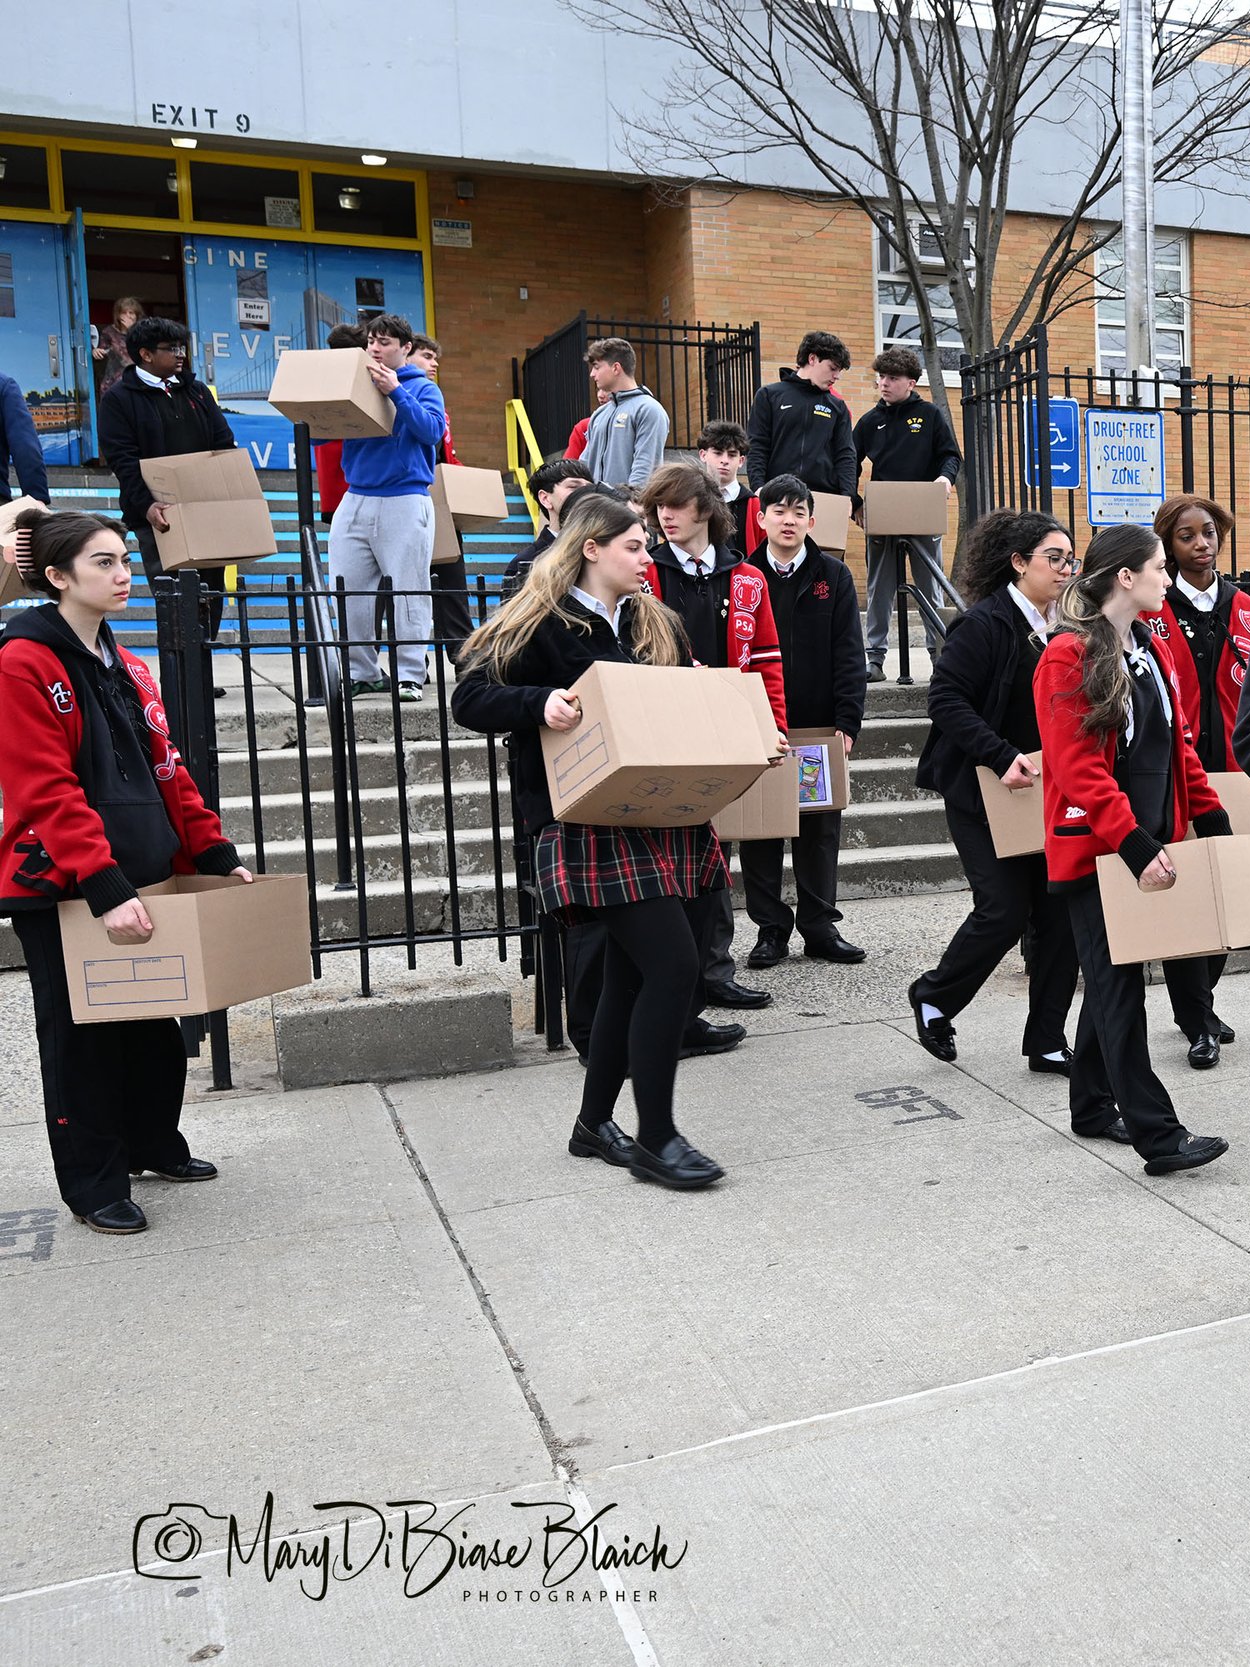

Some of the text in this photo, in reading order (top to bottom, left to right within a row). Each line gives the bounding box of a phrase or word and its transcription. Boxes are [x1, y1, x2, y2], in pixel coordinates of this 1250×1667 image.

[152, 103, 250, 133] EXIT 9
[183, 245, 268, 269] GINE
[1093, 421, 1156, 439] DRUG-FREE
[1103, 444, 1148, 462] SCHOOL
[1111, 468, 1141, 485] ZONE
[735, 618, 754, 634] PSA
[1148, 616, 1170, 640] MC
